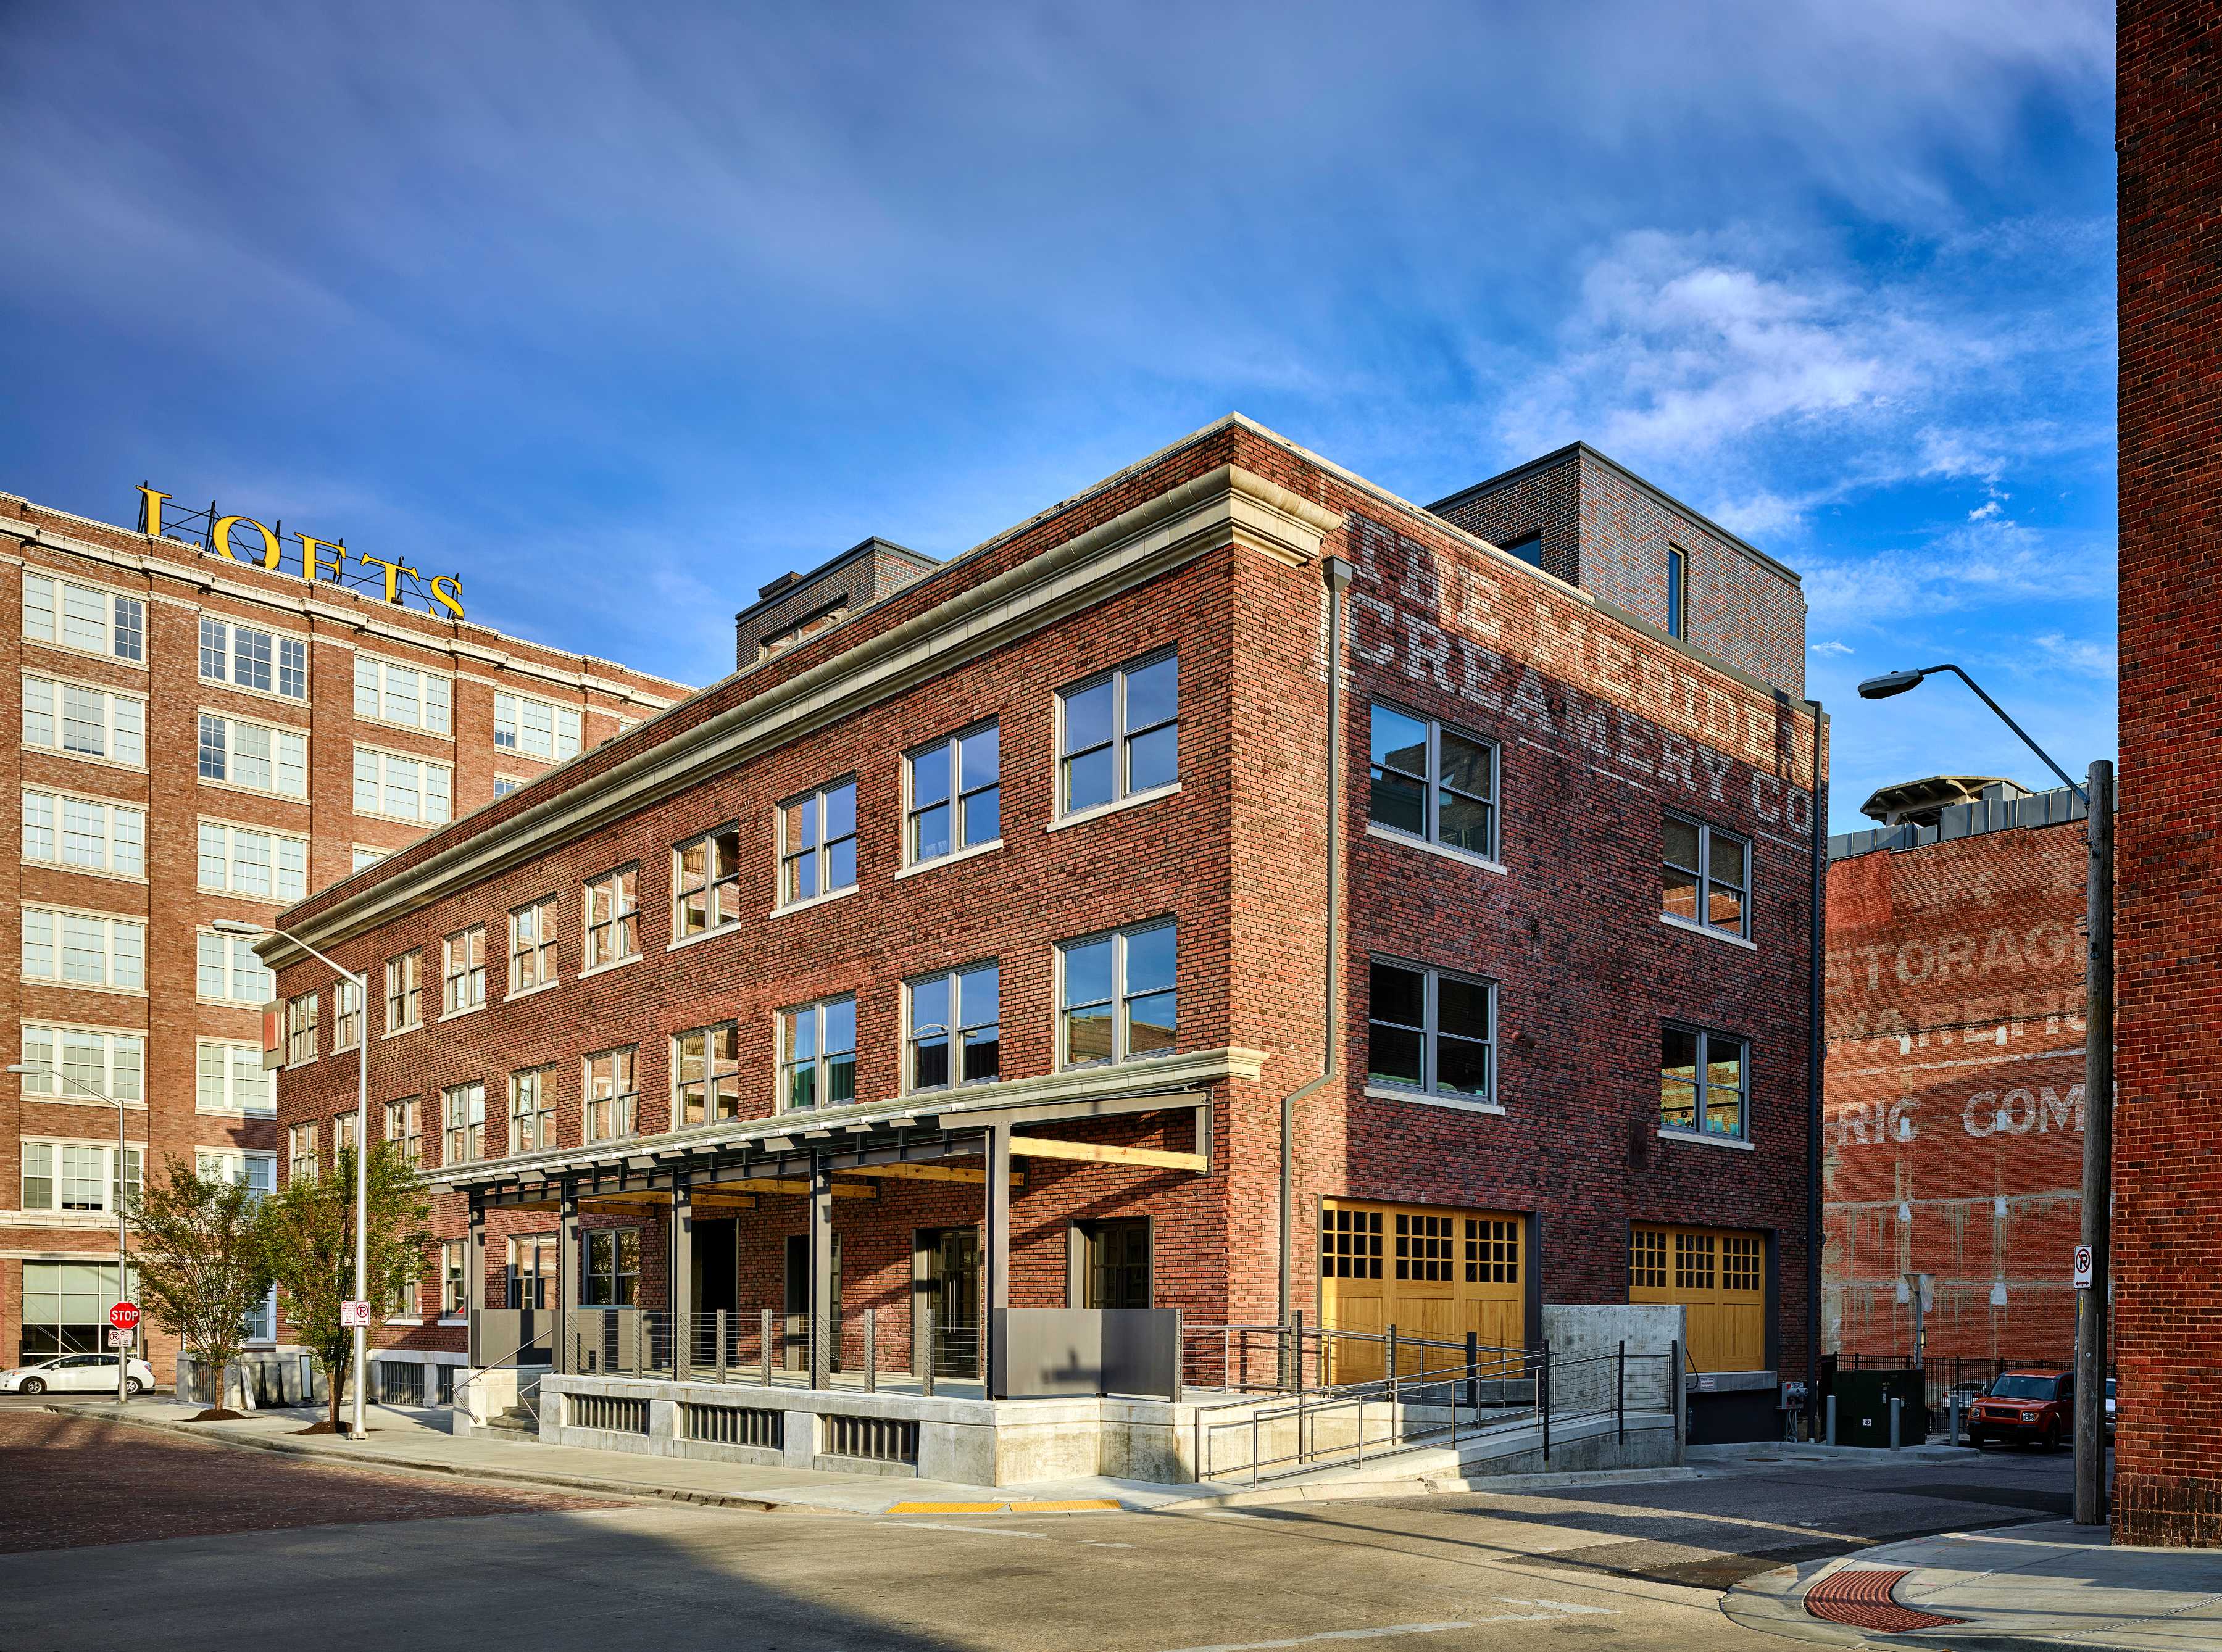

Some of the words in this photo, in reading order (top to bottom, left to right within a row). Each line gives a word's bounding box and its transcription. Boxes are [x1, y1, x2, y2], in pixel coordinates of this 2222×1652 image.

[136, 485, 465, 619] LOFTS
[1350, 592, 1733, 802] CREAMERY
[1749, 770, 1813, 836] CO
[1963, 1081, 2118, 1137] COM
[111, 1310, 139, 1321] STOP
